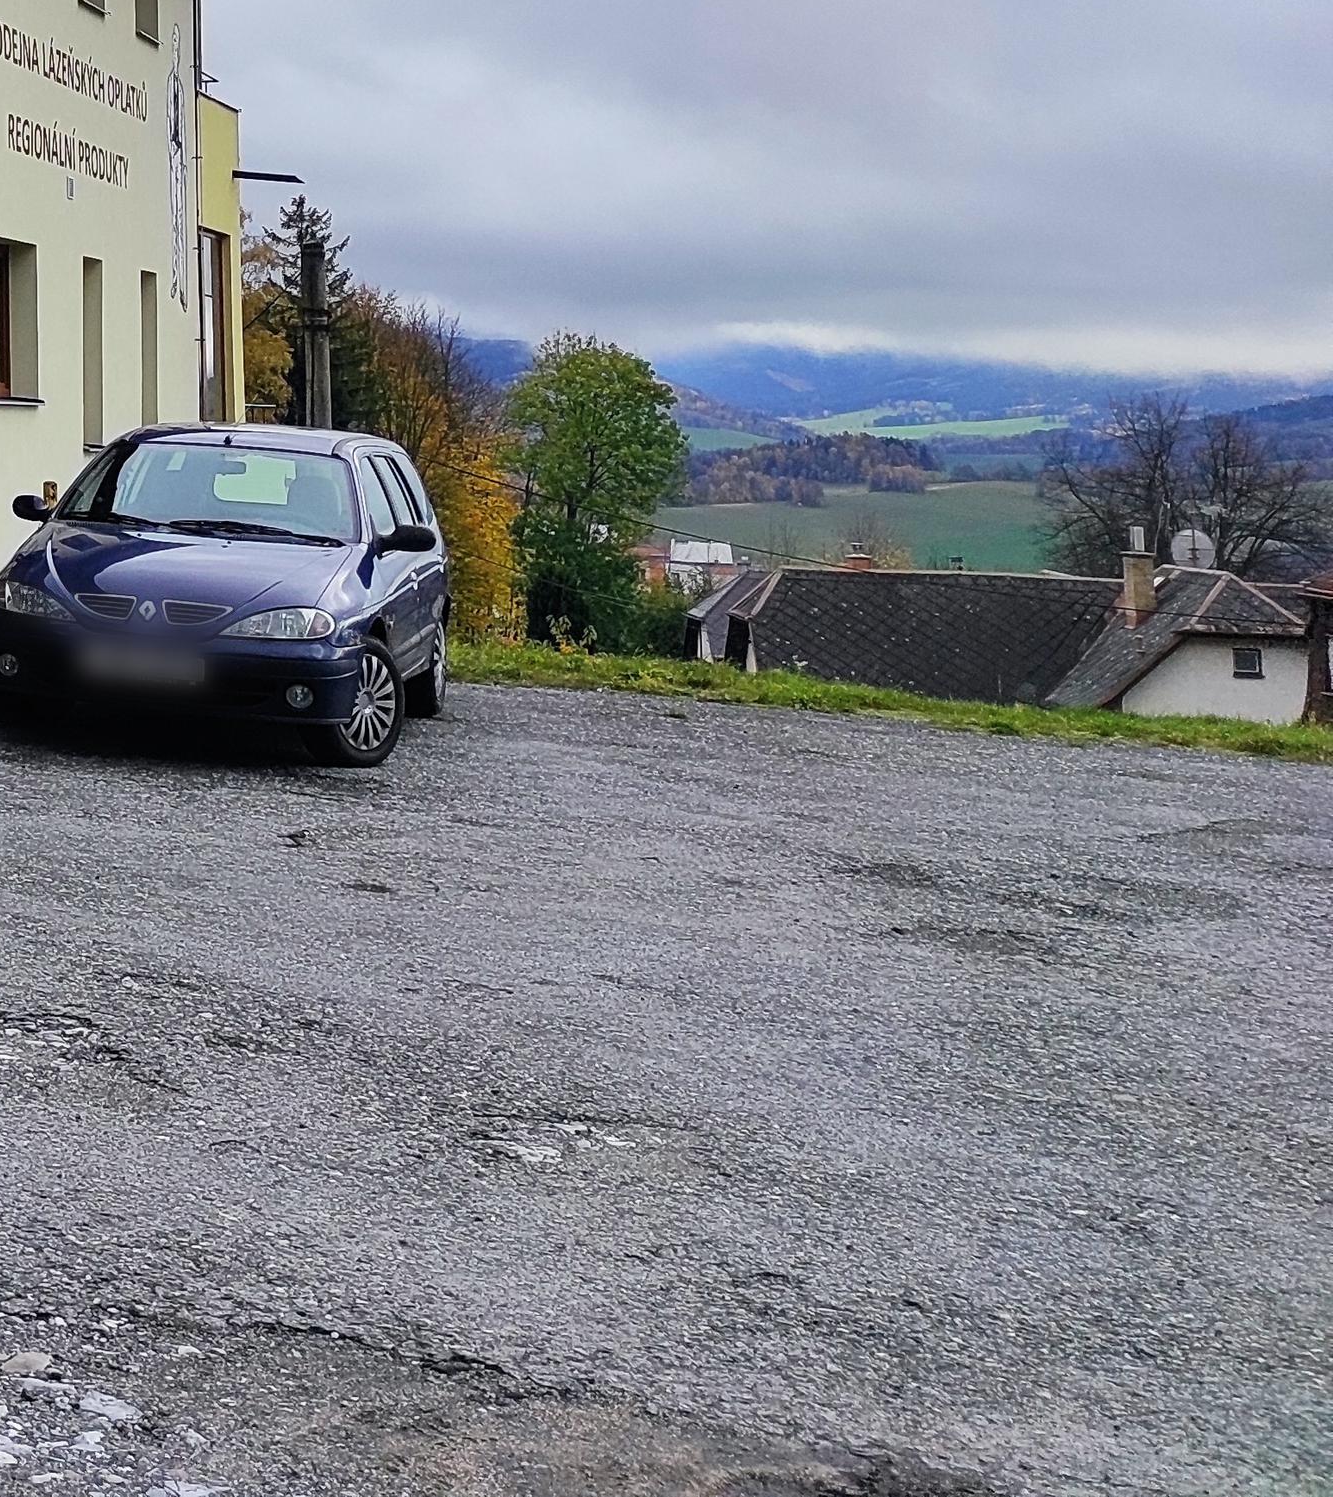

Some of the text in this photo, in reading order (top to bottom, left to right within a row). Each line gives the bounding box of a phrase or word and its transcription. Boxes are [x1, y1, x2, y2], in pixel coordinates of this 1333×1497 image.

[42, 37, 105, 104] LÁZEŇSKÝCH
[107, 74, 148, 122] OPLATKŮ
[8, 113, 129, 189] REGIONÁLNÍ PRODUKTY
